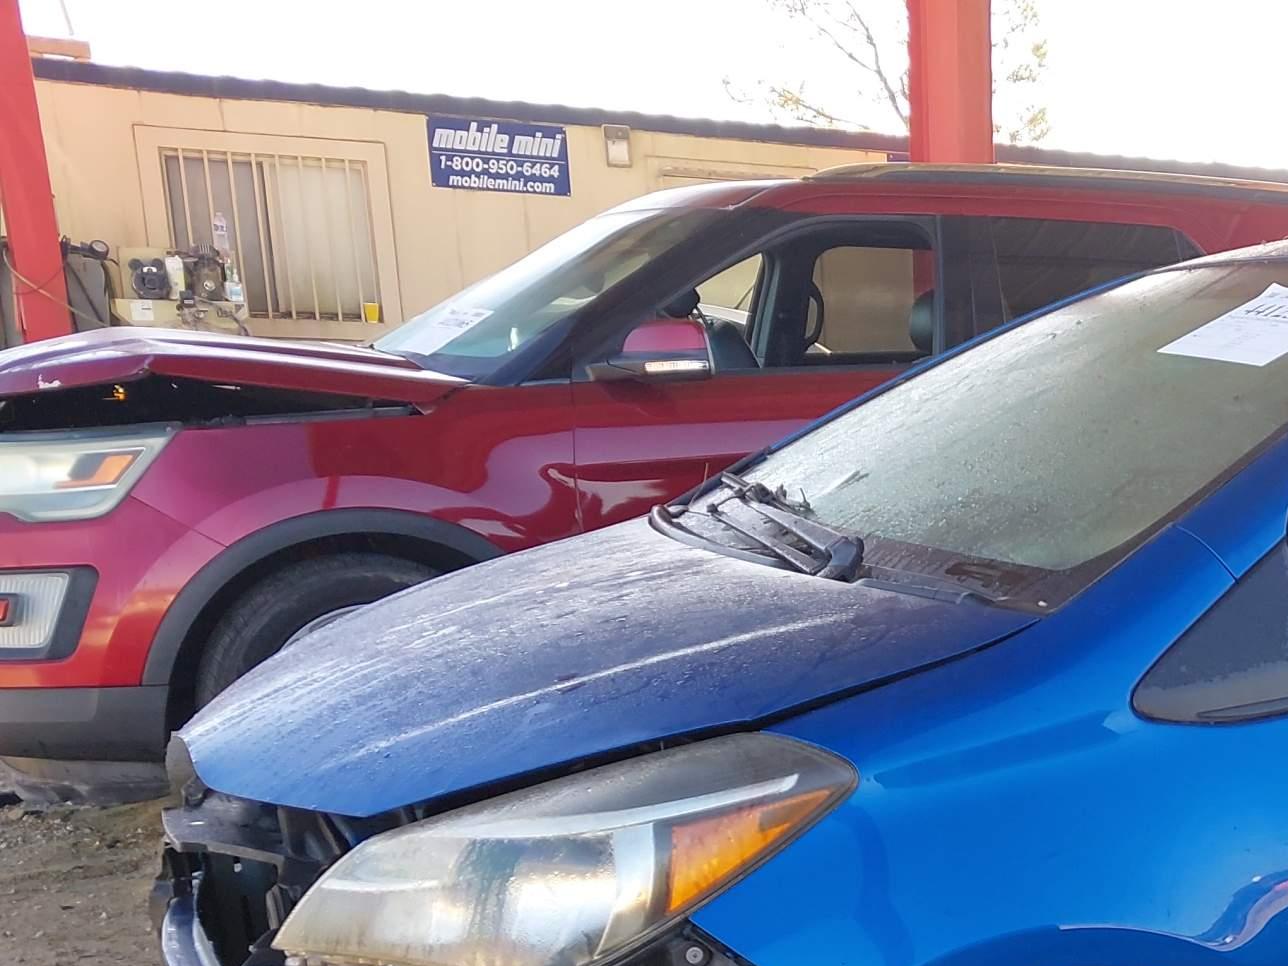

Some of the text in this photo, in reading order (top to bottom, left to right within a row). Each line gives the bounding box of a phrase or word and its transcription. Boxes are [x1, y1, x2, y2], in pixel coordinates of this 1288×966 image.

[433, 122, 562, 157] mobile mini
[440, 155, 560, 178] 1-800-950-6464
[449, 174, 555, 193] mobilemini.com
